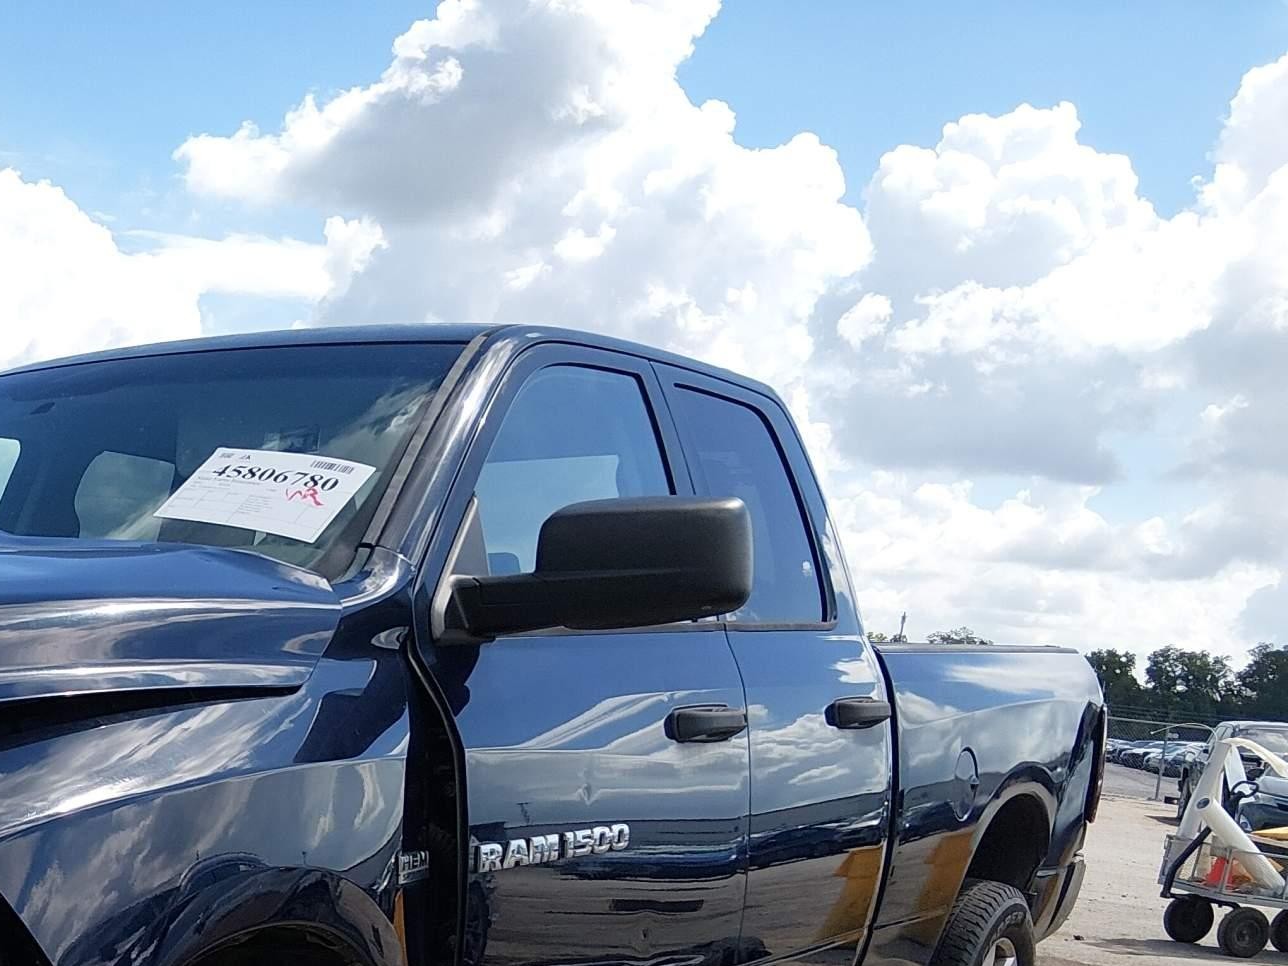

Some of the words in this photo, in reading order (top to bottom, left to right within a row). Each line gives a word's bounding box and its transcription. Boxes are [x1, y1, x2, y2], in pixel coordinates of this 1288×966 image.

[213, 464, 339, 492] 45806780
[478, 833, 560, 873] RAM
[562, 823, 630, 859] 1500
